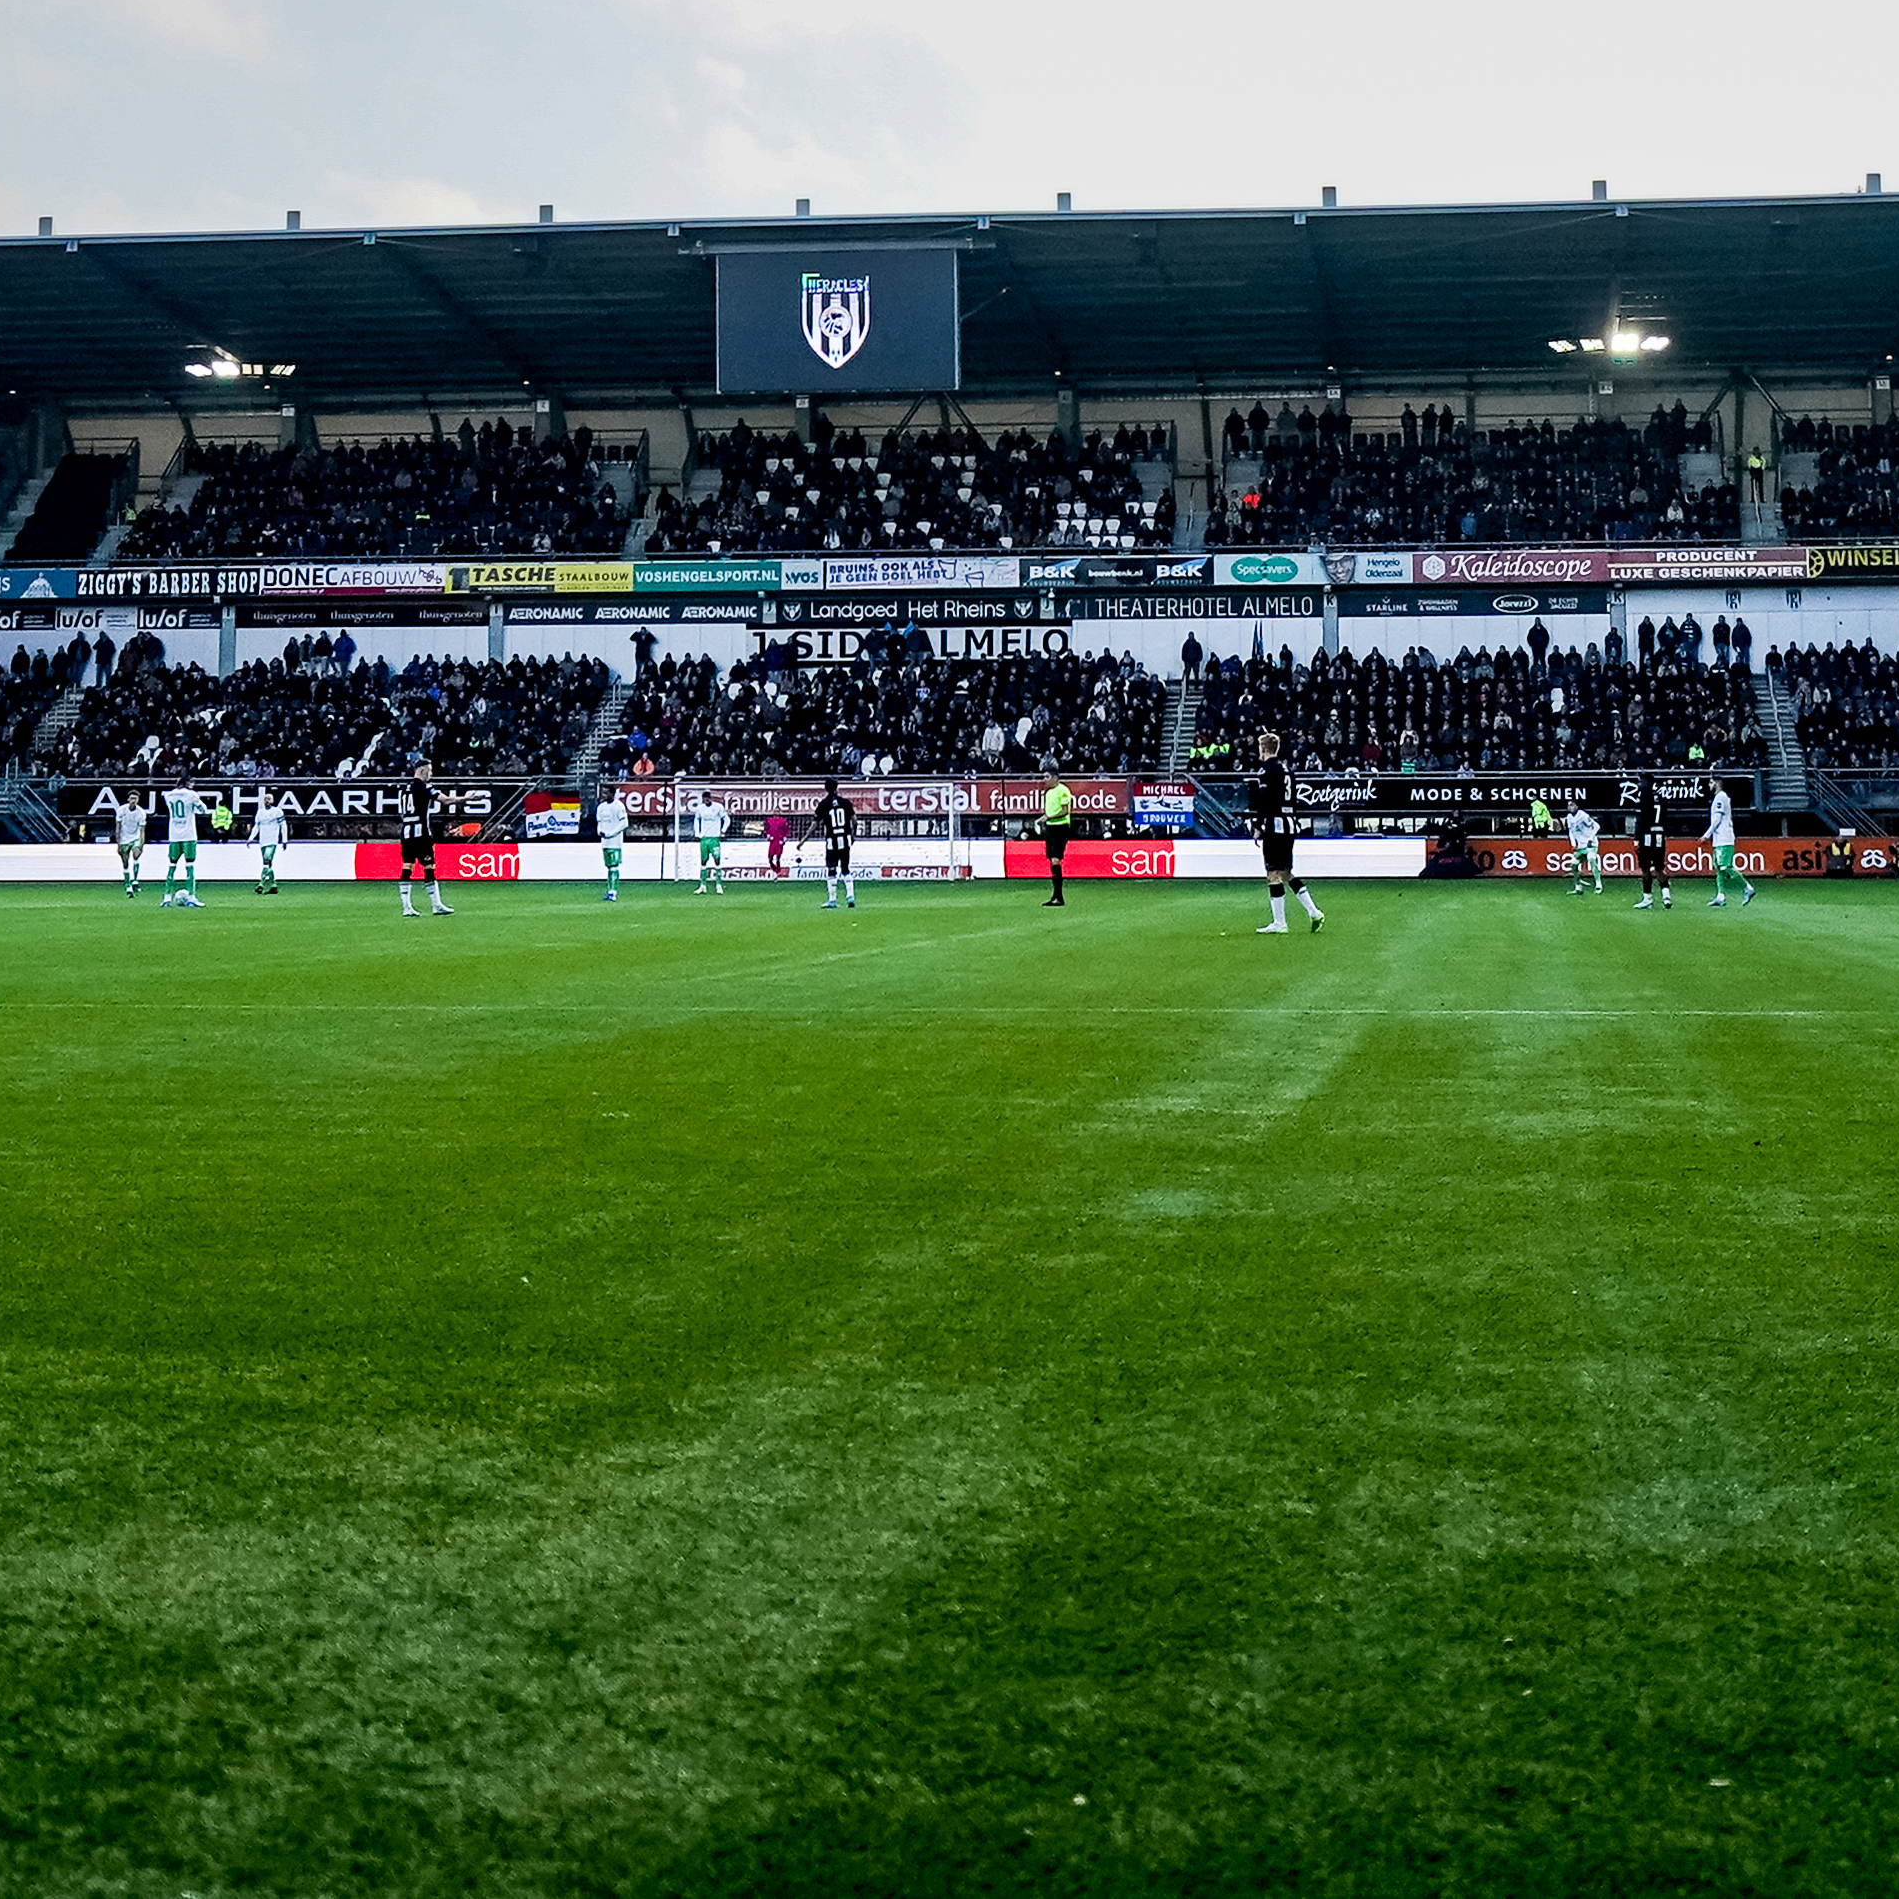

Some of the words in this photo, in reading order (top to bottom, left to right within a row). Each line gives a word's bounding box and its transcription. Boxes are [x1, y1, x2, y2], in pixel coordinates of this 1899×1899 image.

[1367, 558, 1401, 570] Hengelo
[1656, 550, 1758, 563] PRODUCENT
[881, 561, 908, 573] OOK
[912, 560, 935, 571] ALS
[1029, 565, 1076, 579] B&K
[1156, 563, 1203, 578] B&K
[1236, 563, 1293, 576] Specsavers
[1365, 568, 1404, 579] Oldenzaal
[1451, 553, 1592, 582] Kaleidoscope
[1610, 567, 1654, 580] LUXE
[1659, 566, 1805, 579] GESCHENKPAPIER
[263, 566, 338, 587] DONEC
[340, 570, 418, 587] AFBOUW
[473, 567, 556, 582] TASCHE
[559, 571, 630, 582] STAALBOUW
[635, 569, 780, 583] VOSHENGELSPORT.NL
[845, 572, 878, 583] GEEN
[881, 571, 915, 582] DOEL
[77, 570, 142, 596] ZIGGY'S
[149, 571, 210, 595] BARBER
[217, 570, 259, 594] SHOP
[508, 606, 584, 620] AERONAMIC
[594, 606, 671, 620] AERONAMIC
[680, 605, 758, 619] AERONAMIC
[810, 600, 898, 622] Landgoed
[908, 599, 941, 619] Het
[944, 599, 1006, 619] Rheins
[1094, 597, 1238, 618] THEATERHOTEL
[1241, 595, 1314, 617] ALMELO
[1365, 603, 1409, 613] STARLINE
[791, 631, 868, 659] SID
[1284, 774, 1292, 801] 3
[1410, 788, 1463, 802] MODE
[1469, 788, 1483, 802] &
[1490, 786, 1587, 802] SCHOENEN
[615, 785, 703, 814] terSta
[724, 790, 821, 813] familiemo
[877, 784, 981, 813] terStal
[990, 788, 1117, 811] familimode
[169, 798, 186, 819] 10
[1653, 804, 1661, 823] 7
[828, 807, 845, 828] 10
[1545, 851, 1634, 872] saen
[1666, 847, 1765, 872] schon
[1782, 841, 1823, 871] asi
